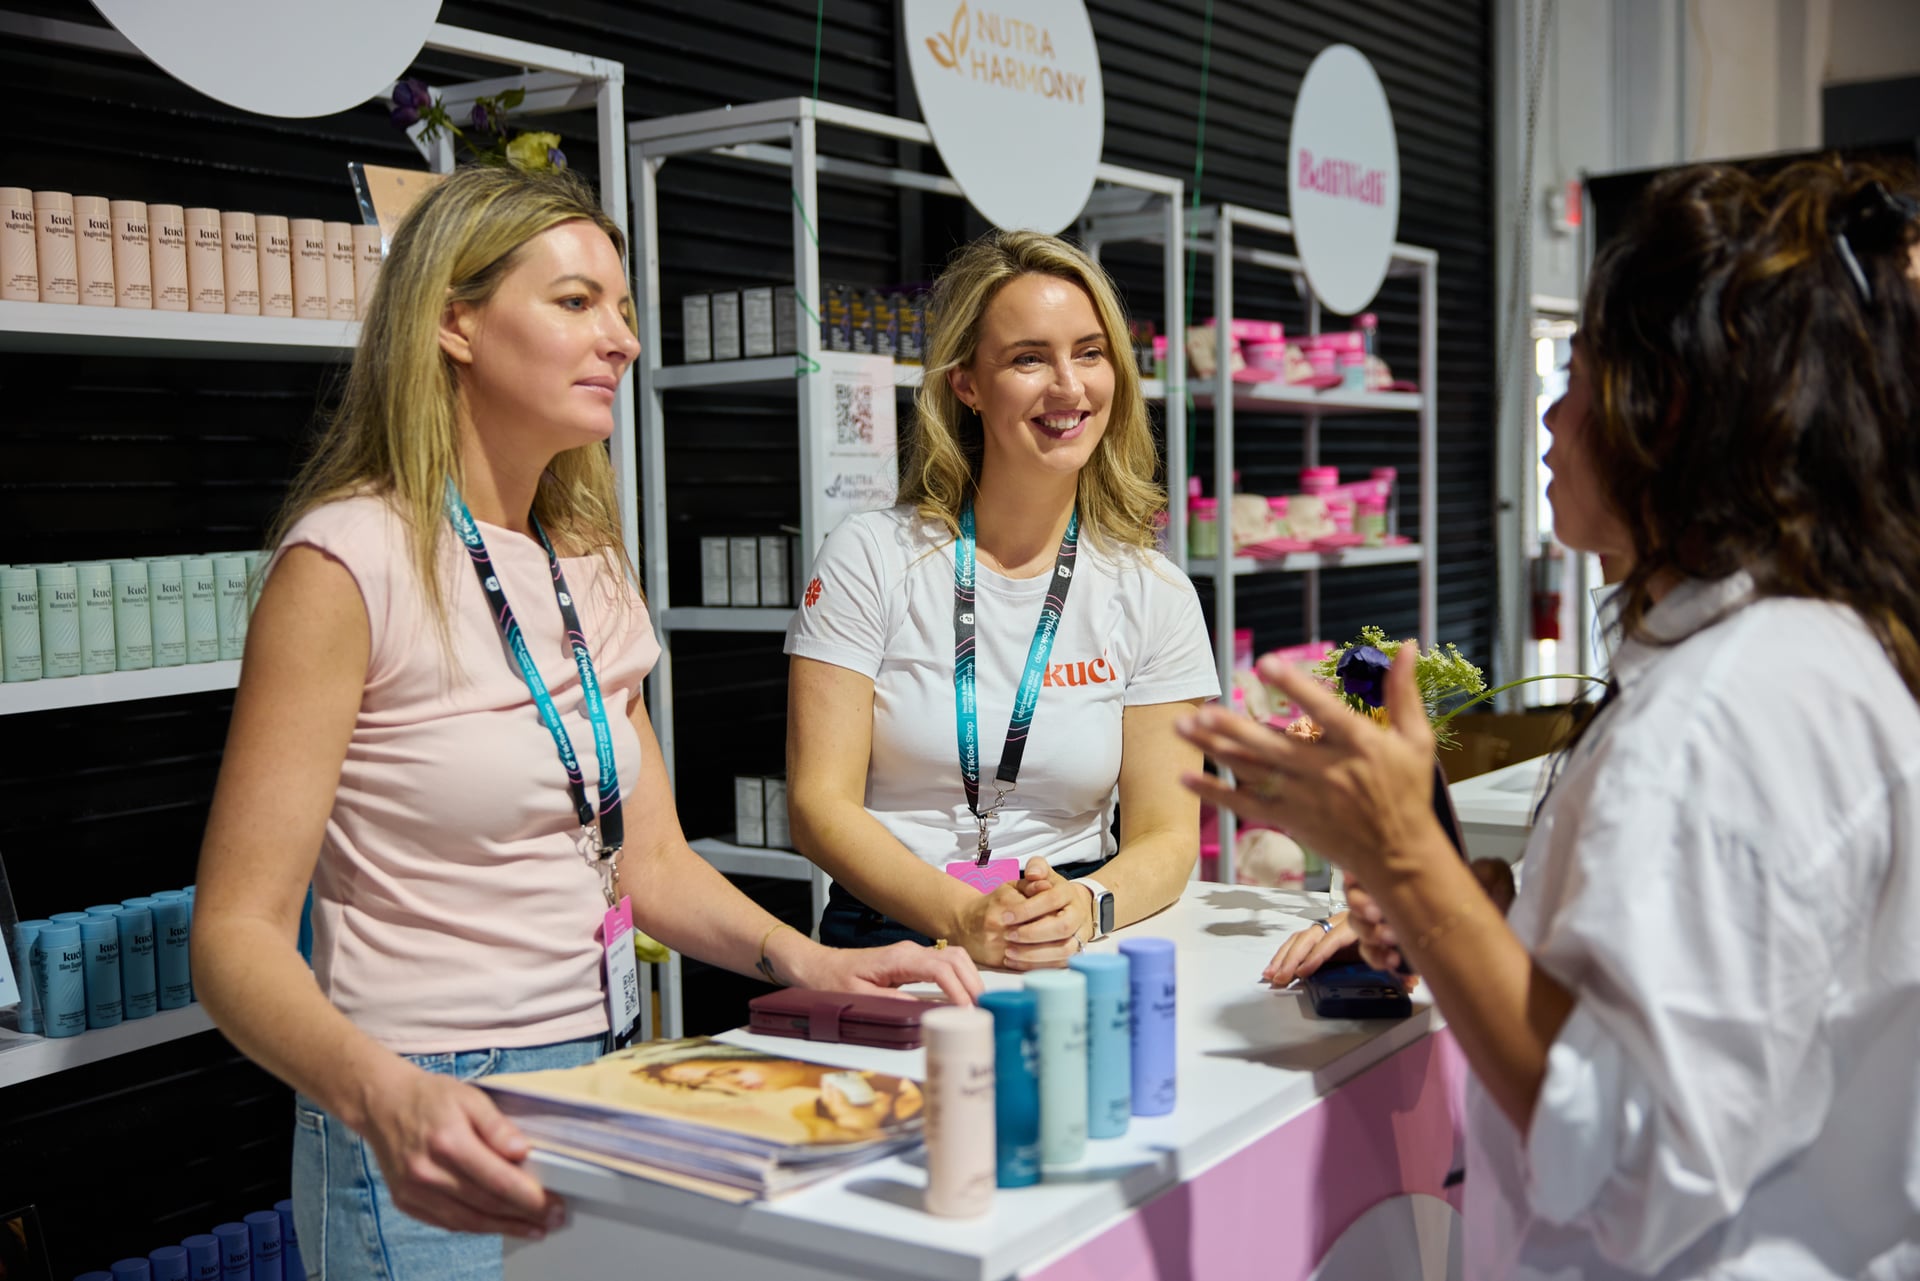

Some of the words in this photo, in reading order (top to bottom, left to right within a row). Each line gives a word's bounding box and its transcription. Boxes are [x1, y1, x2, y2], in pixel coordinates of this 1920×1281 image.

[976, 10, 1056, 60] NUTRA
[970, 49, 1086, 105] HARMONY
[11, 210, 32, 221] kuci
[51, 214, 72, 225] kuci
[89, 218, 109, 230] kuci
[127, 223, 146, 233] kuci
[164, 226, 183, 237] kuci
[17, 592, 36, 602] kuci
[56, 589, 76, 600] kuci
[92, 588, 111, 598] kuci
[1040, 619, 1055, 644] TikTok
[1034, 645, 1047, 663] Shop
[1042, 648, 1117, 687] kuci
[581, 660, 593, 688] TikTok
[588, 689, 599, 714] Shop
[544, 703, 560, 727] Shop
[966, 721, 975, 742] Shop
[557, 728, 571, 759] TikTok
[966, 743, 975, 770] TikTok
[63, 948, 81, 962] kuci
